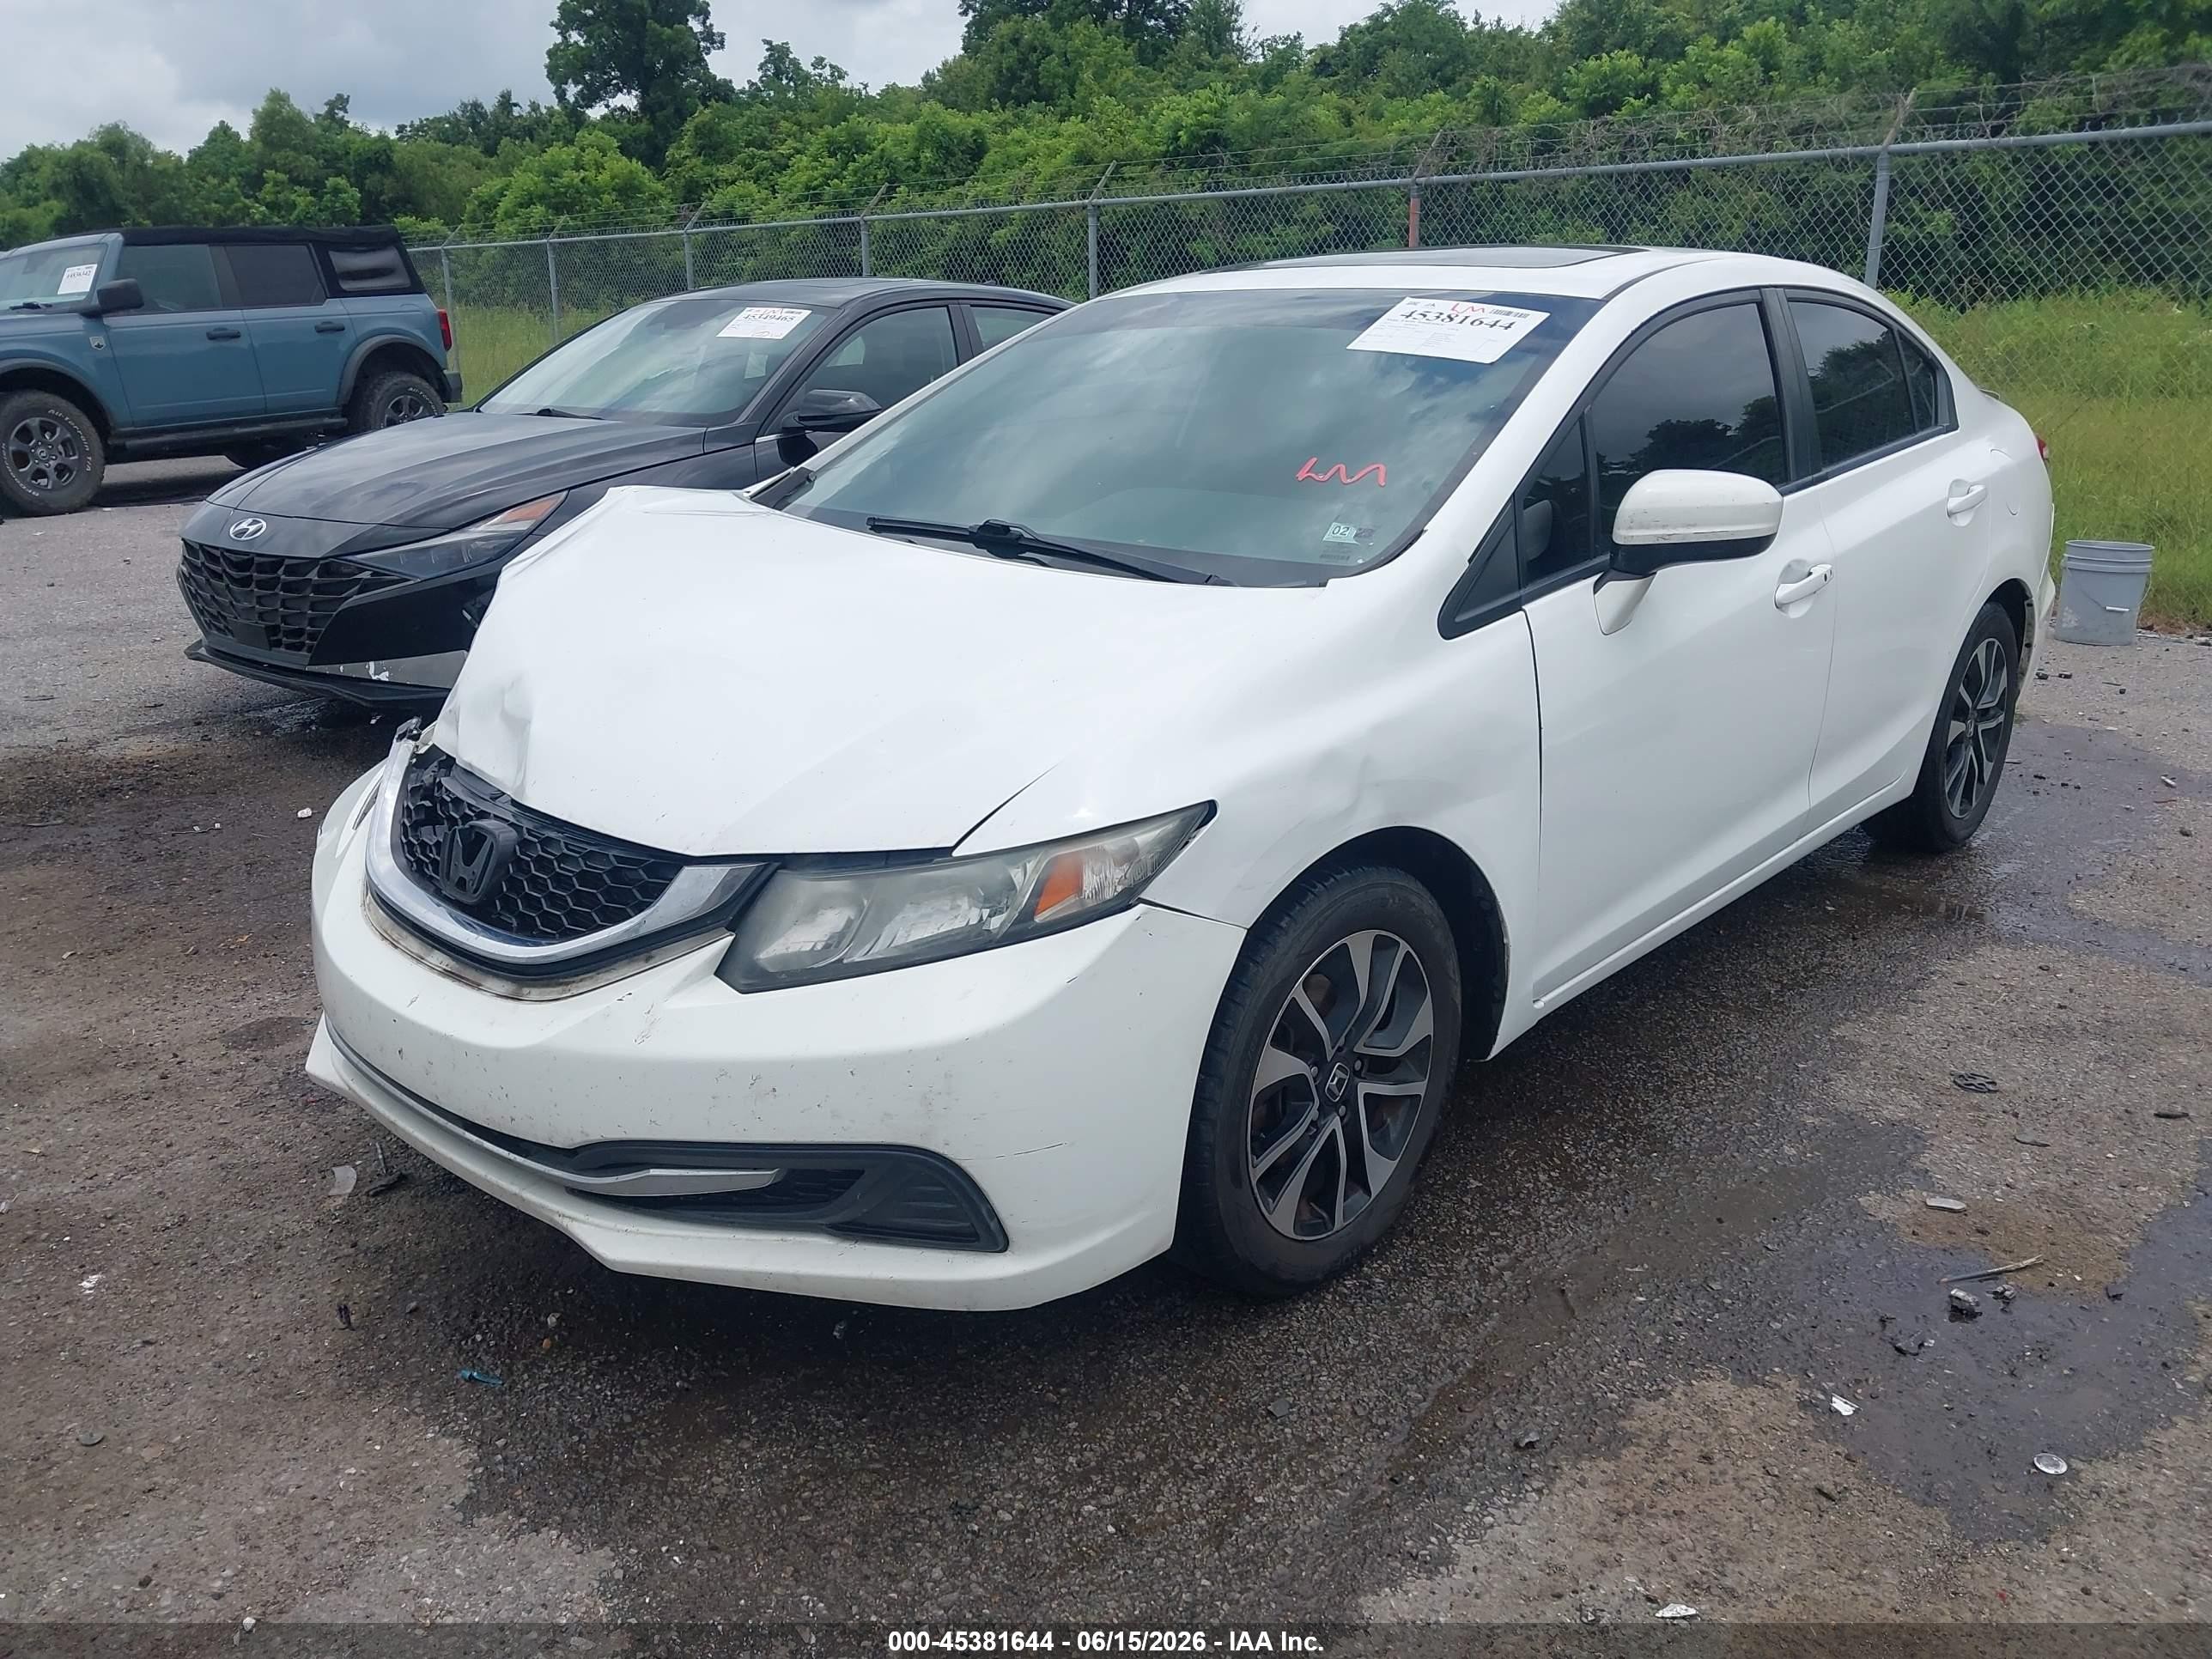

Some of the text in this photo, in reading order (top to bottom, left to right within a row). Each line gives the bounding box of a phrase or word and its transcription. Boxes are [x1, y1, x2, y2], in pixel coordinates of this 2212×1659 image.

[1449, 302, 1486, 314] LM
[1400, 309, 1516, 331] 45381644
[1332, 525, 1350, 536] 02
